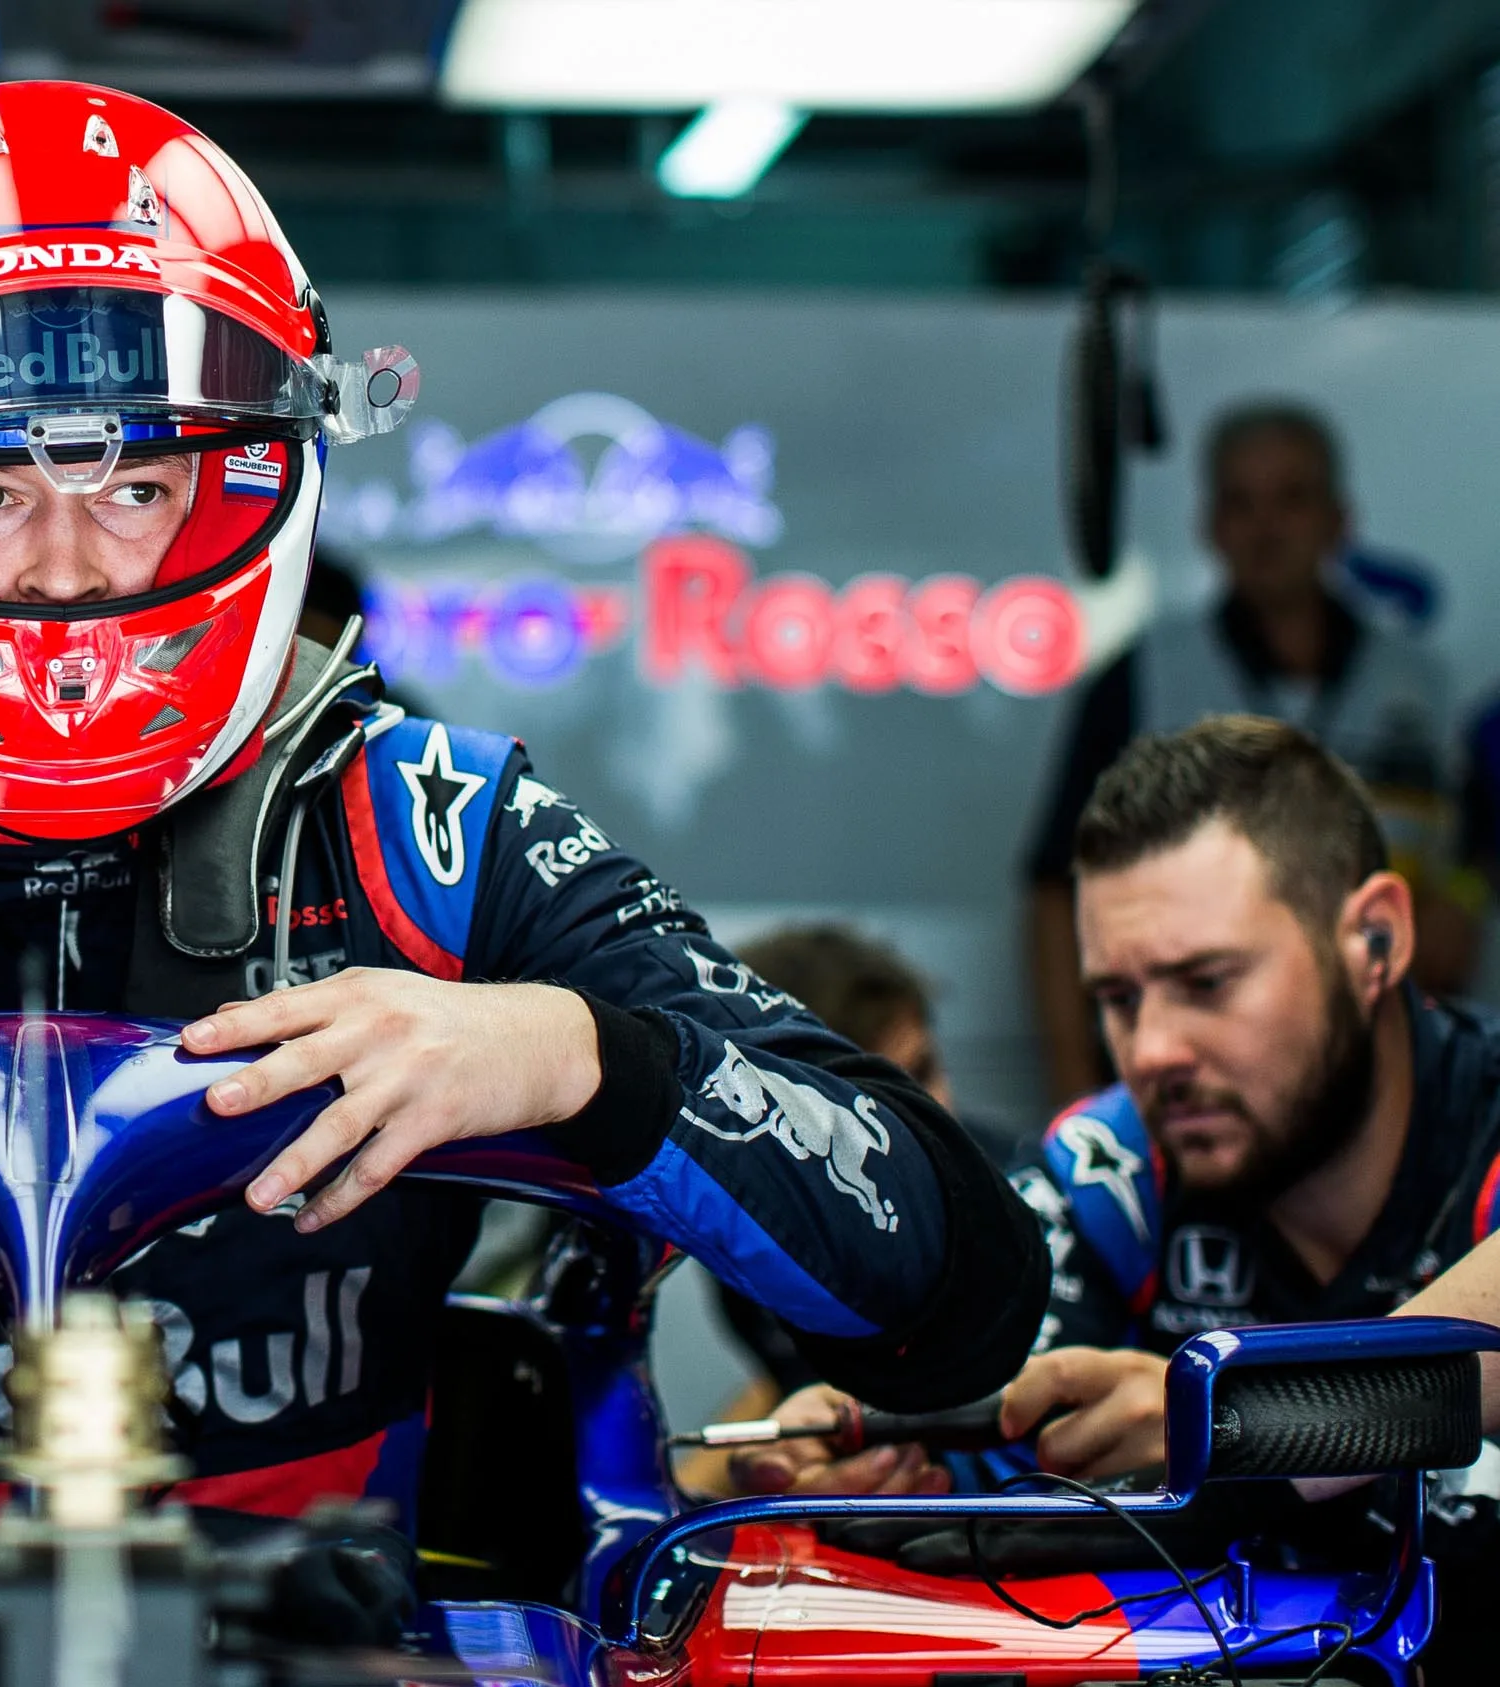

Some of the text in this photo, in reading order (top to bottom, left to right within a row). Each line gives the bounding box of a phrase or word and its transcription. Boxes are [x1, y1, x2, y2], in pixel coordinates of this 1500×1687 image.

[66, 327, 167, 384] Bull
[226, 458, 279, 474] SCHUBERTH
[635, 530, 1090, 697] Rosso
[524, 812, 612, 888] Red
[24, 871, 79, 899] Red
